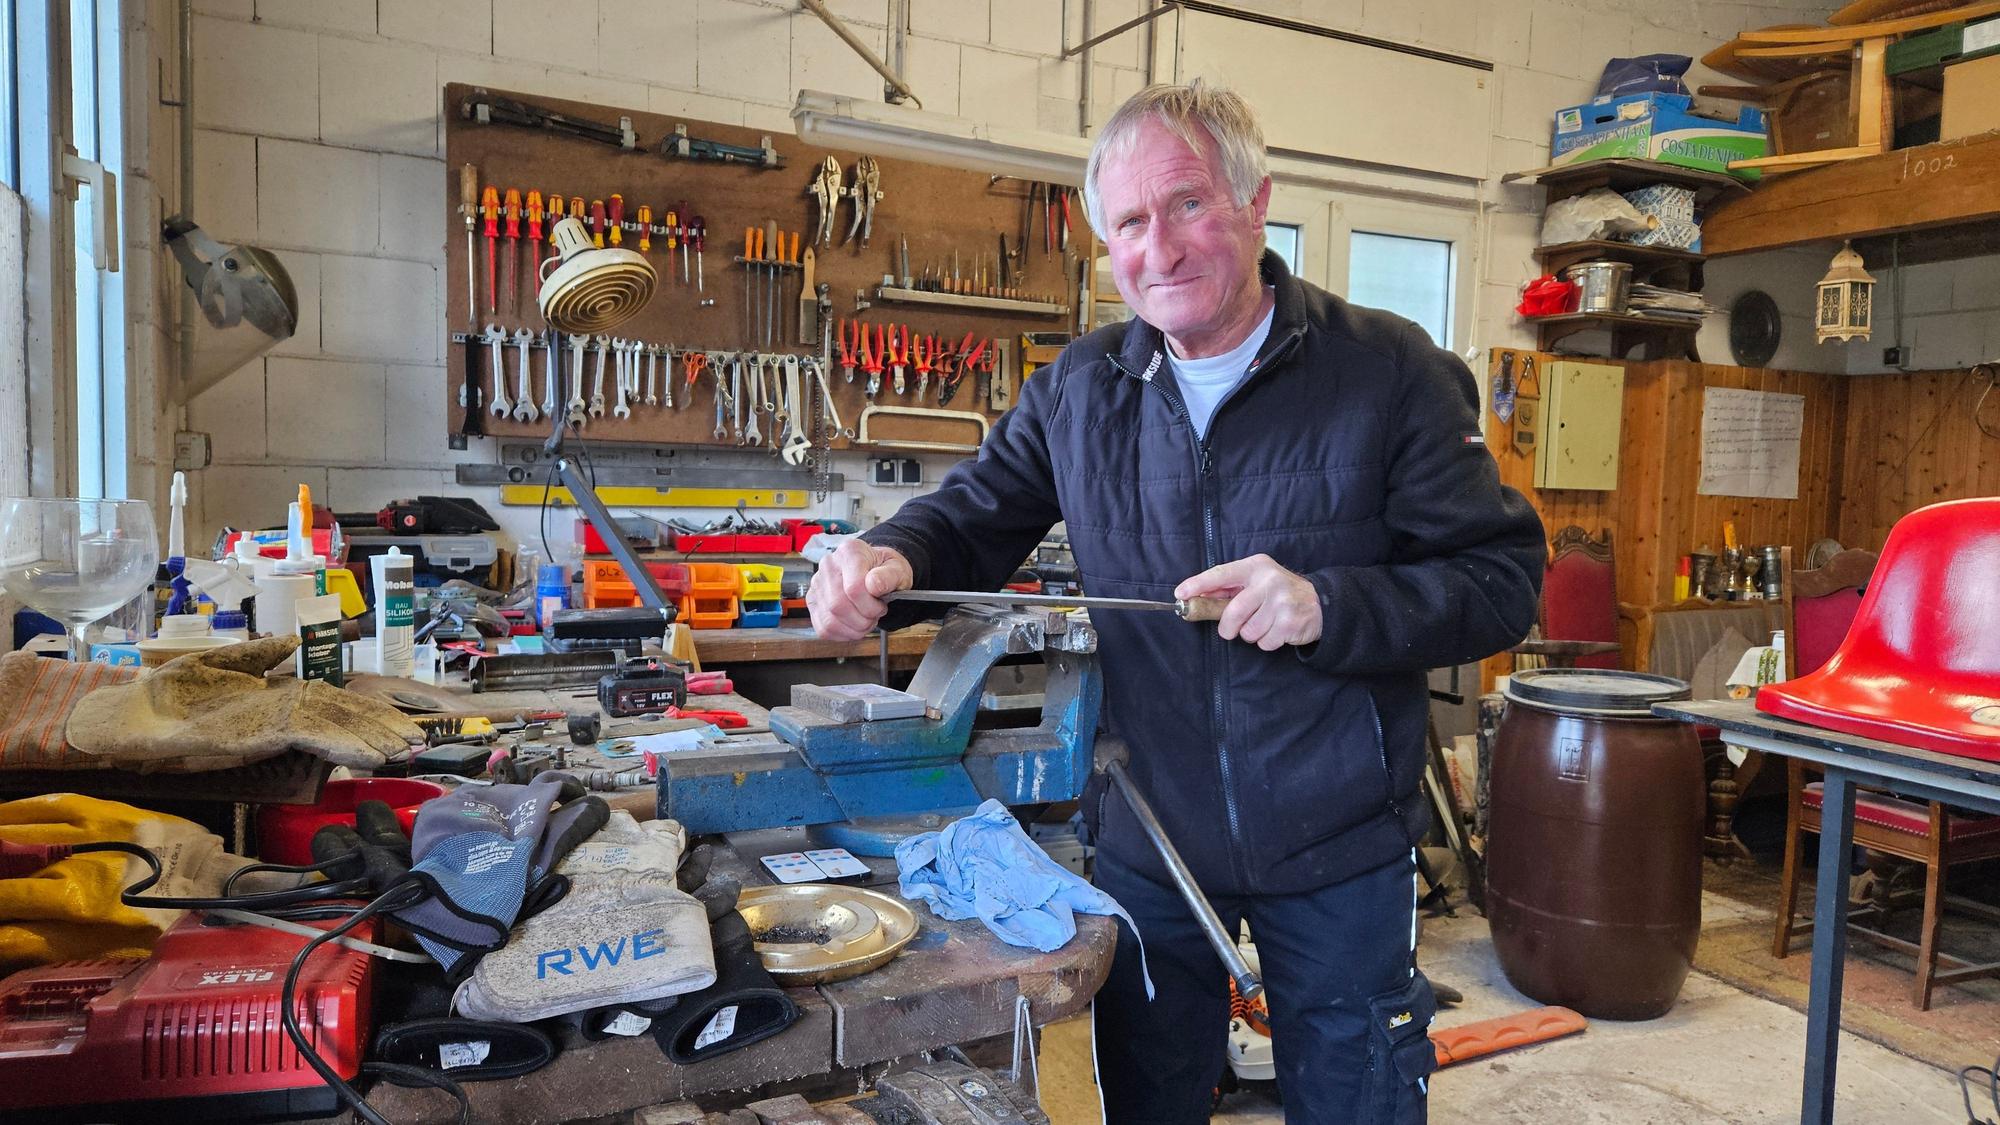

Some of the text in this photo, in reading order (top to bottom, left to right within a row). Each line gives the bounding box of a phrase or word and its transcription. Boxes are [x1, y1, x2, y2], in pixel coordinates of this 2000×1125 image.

[1661, 138, 1696, 157] COSTA
[1698, 144, 1714, 161] DE
[1903, 150, 1958, 179] 1002
[315, 628, 338, 639] PARKSIDE
[651, 691, 673, 701] FLEX
[537, 928, 666, 980] RWE
[198, 971, 274, 985] FLEX
